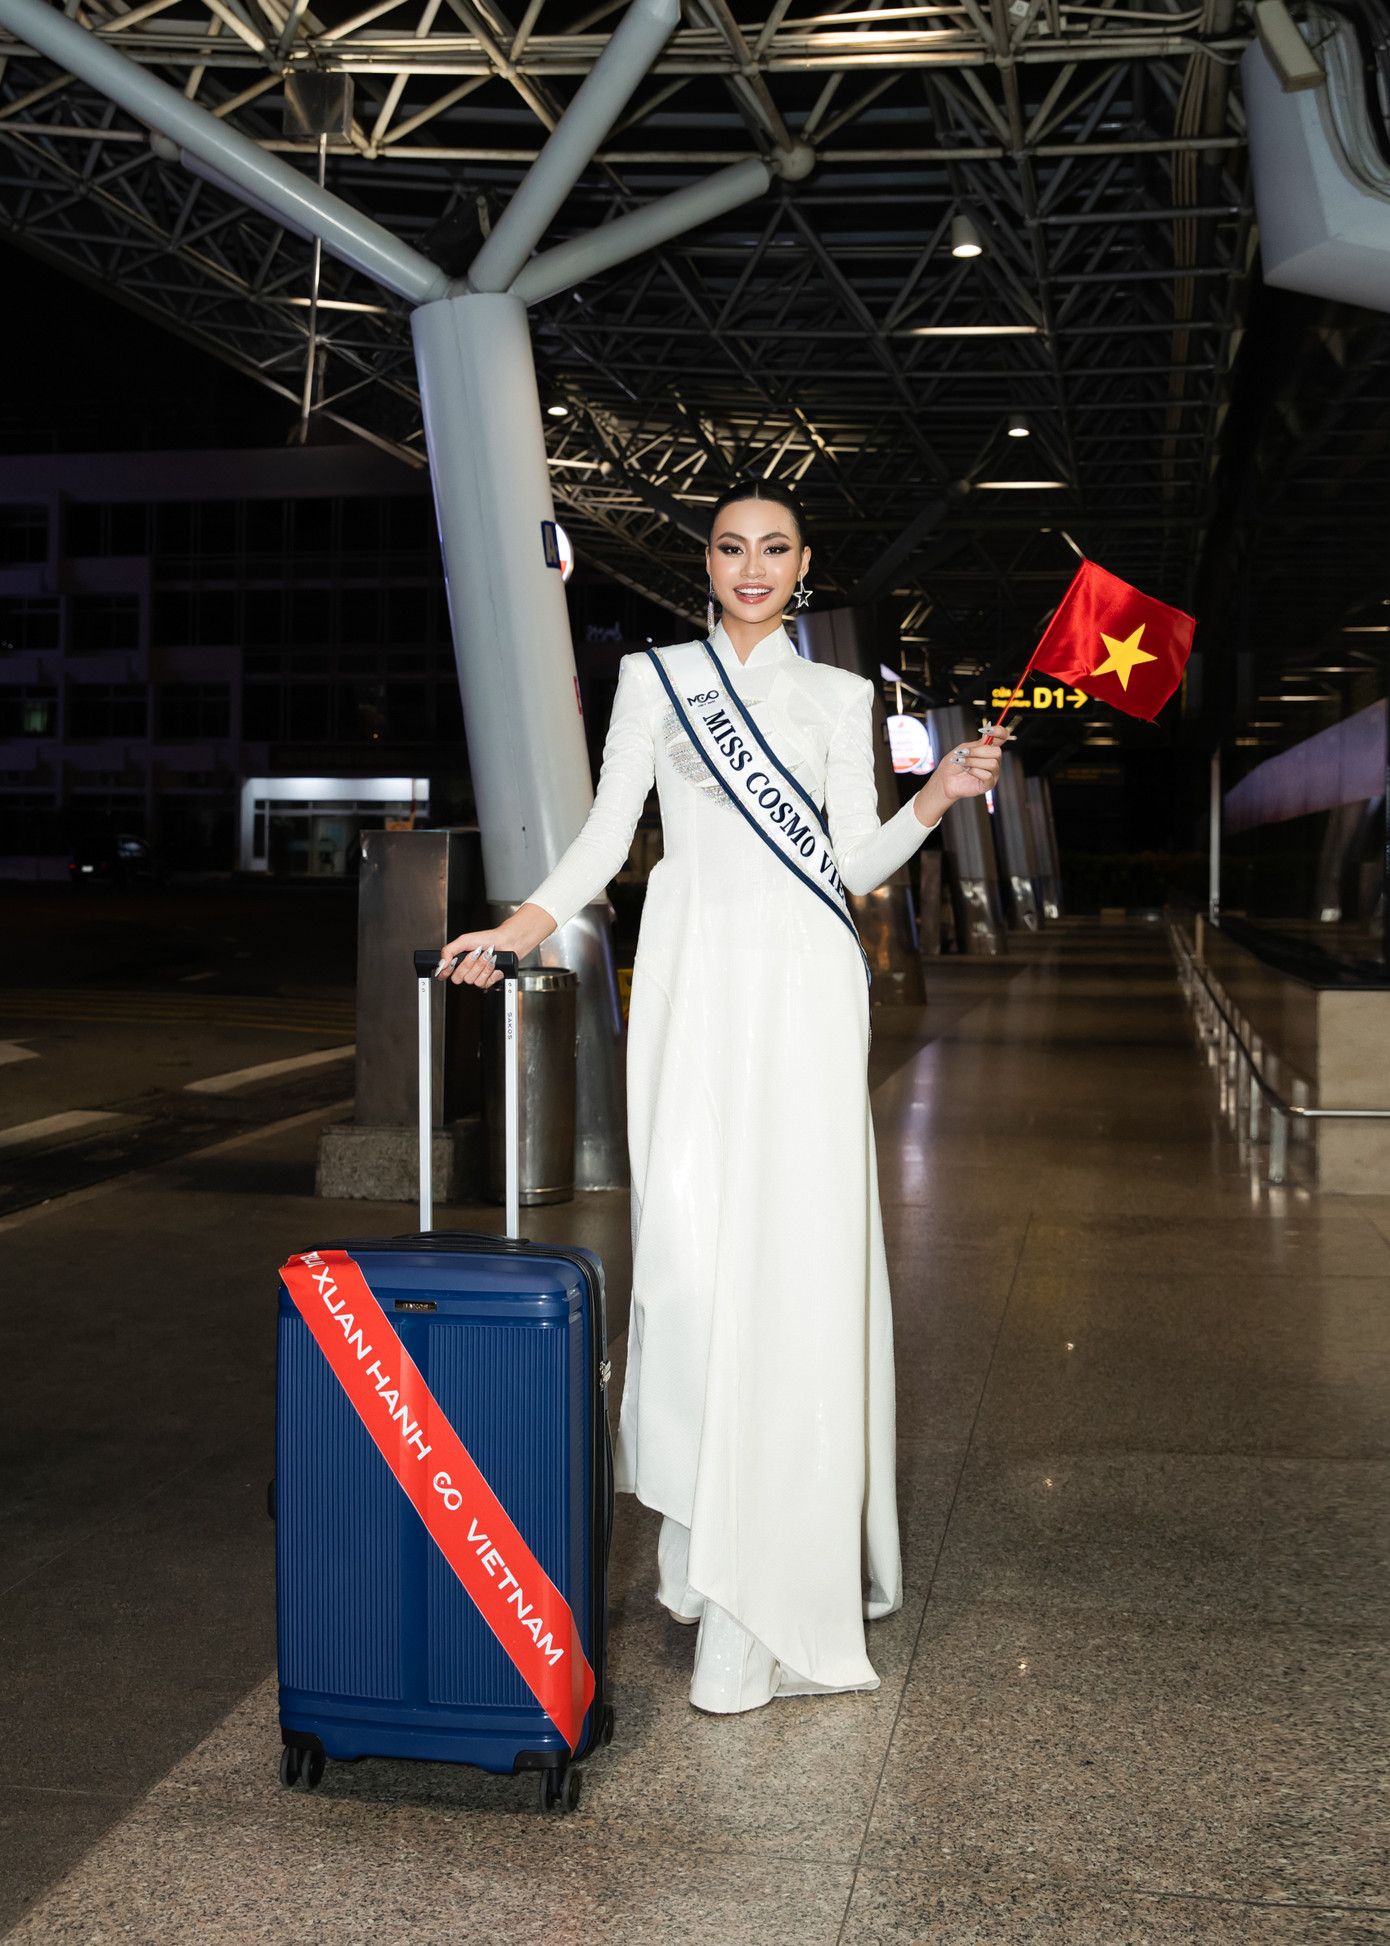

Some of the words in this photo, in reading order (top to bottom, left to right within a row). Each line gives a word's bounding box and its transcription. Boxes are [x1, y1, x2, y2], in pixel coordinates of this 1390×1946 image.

[1033, 687, 1064, 709] D1
[702, 709, 752, 771] MISS
[746, 772, 816, 857] COSMO
[312, 1266, 372, 1360] XUAN
[365, 1360, 432, 1461] HANH
[467, 1517, 564, 1666] VIETNAM
